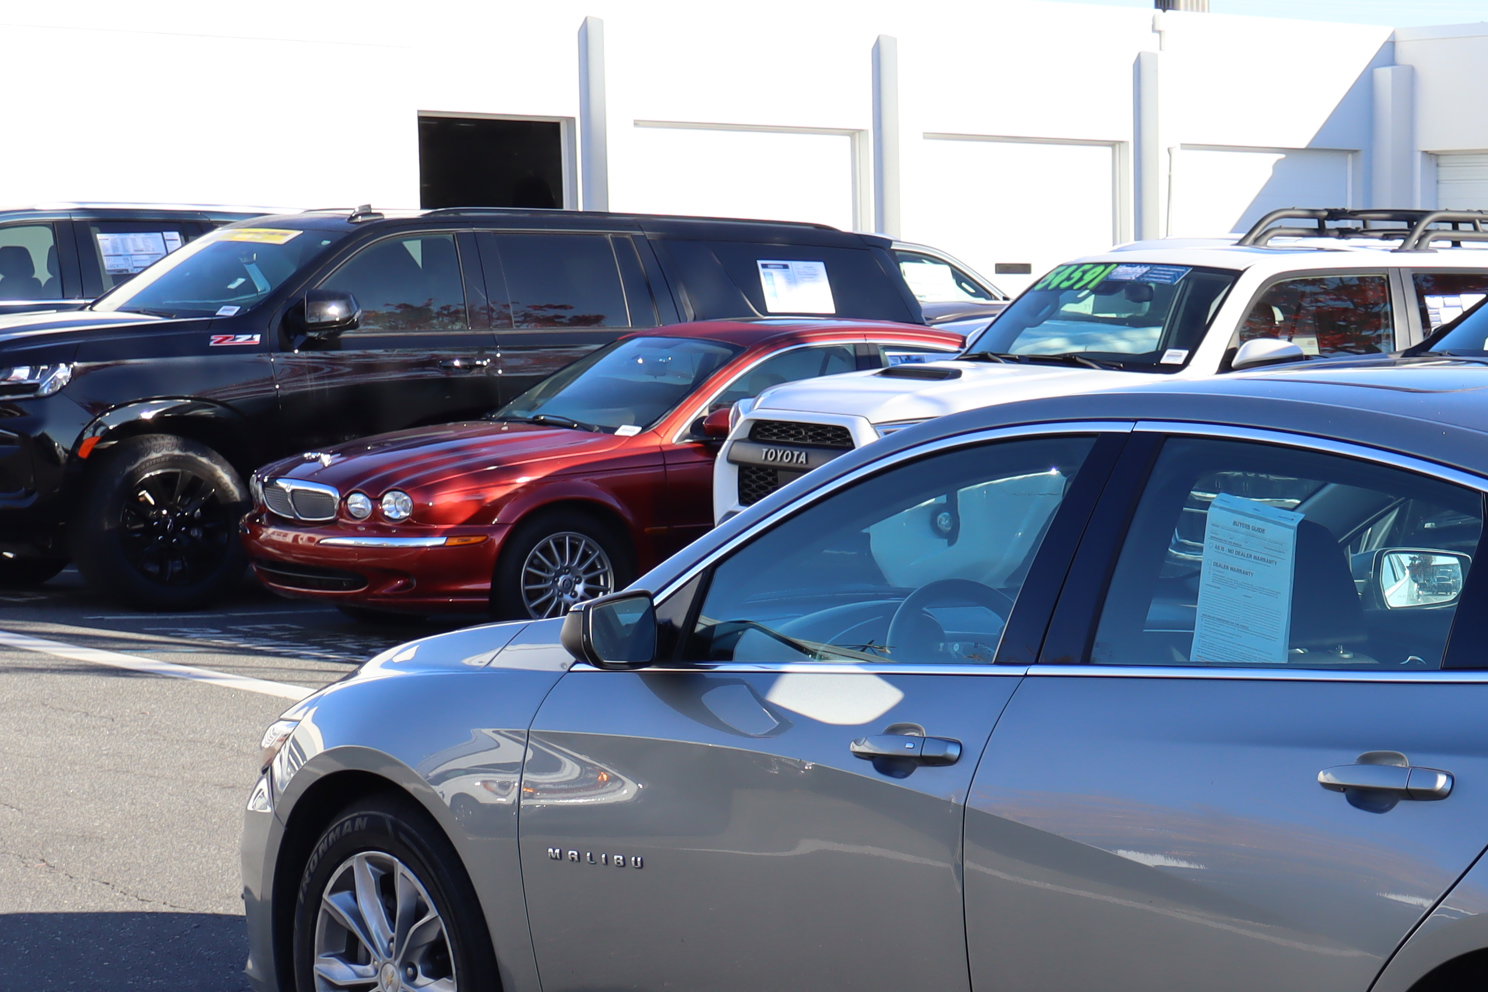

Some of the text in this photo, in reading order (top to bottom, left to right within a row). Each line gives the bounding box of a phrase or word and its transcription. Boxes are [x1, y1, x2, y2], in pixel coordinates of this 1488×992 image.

[209, 333, 261, 347] Z71
[762, 448, 807, 464] TOYOTA
[547, 847, 643, 869] MALIBU
